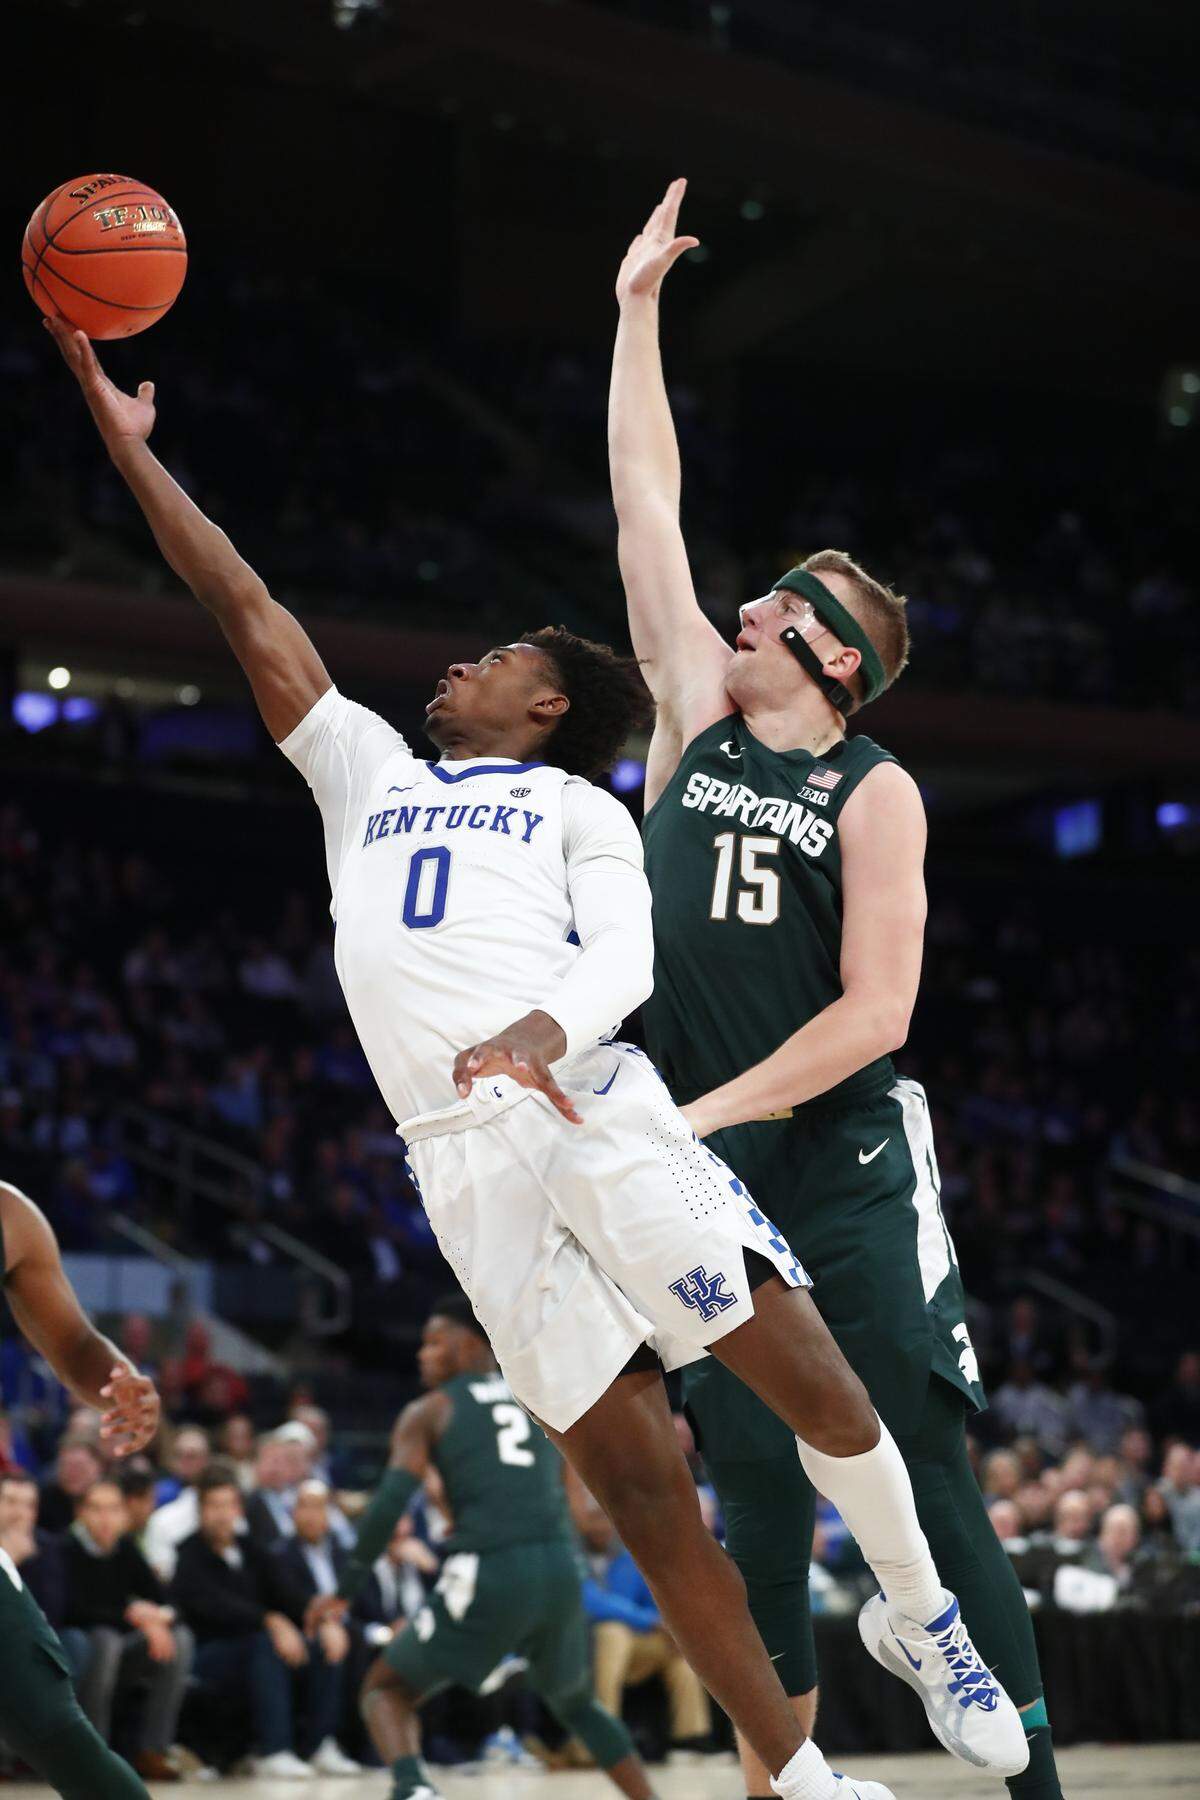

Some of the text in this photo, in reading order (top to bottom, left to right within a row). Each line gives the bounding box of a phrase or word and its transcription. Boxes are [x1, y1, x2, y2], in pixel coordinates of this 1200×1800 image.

[362, 804, 544, 849] KENTUCKY
[681, 772, 835, 858] SPARTANS
[402, 845, 452, 930] 0
[709, 831, 781, 927] 15
[668, 1265, 738, 1323] UK
[491, 1403, 536, 1468] 2
